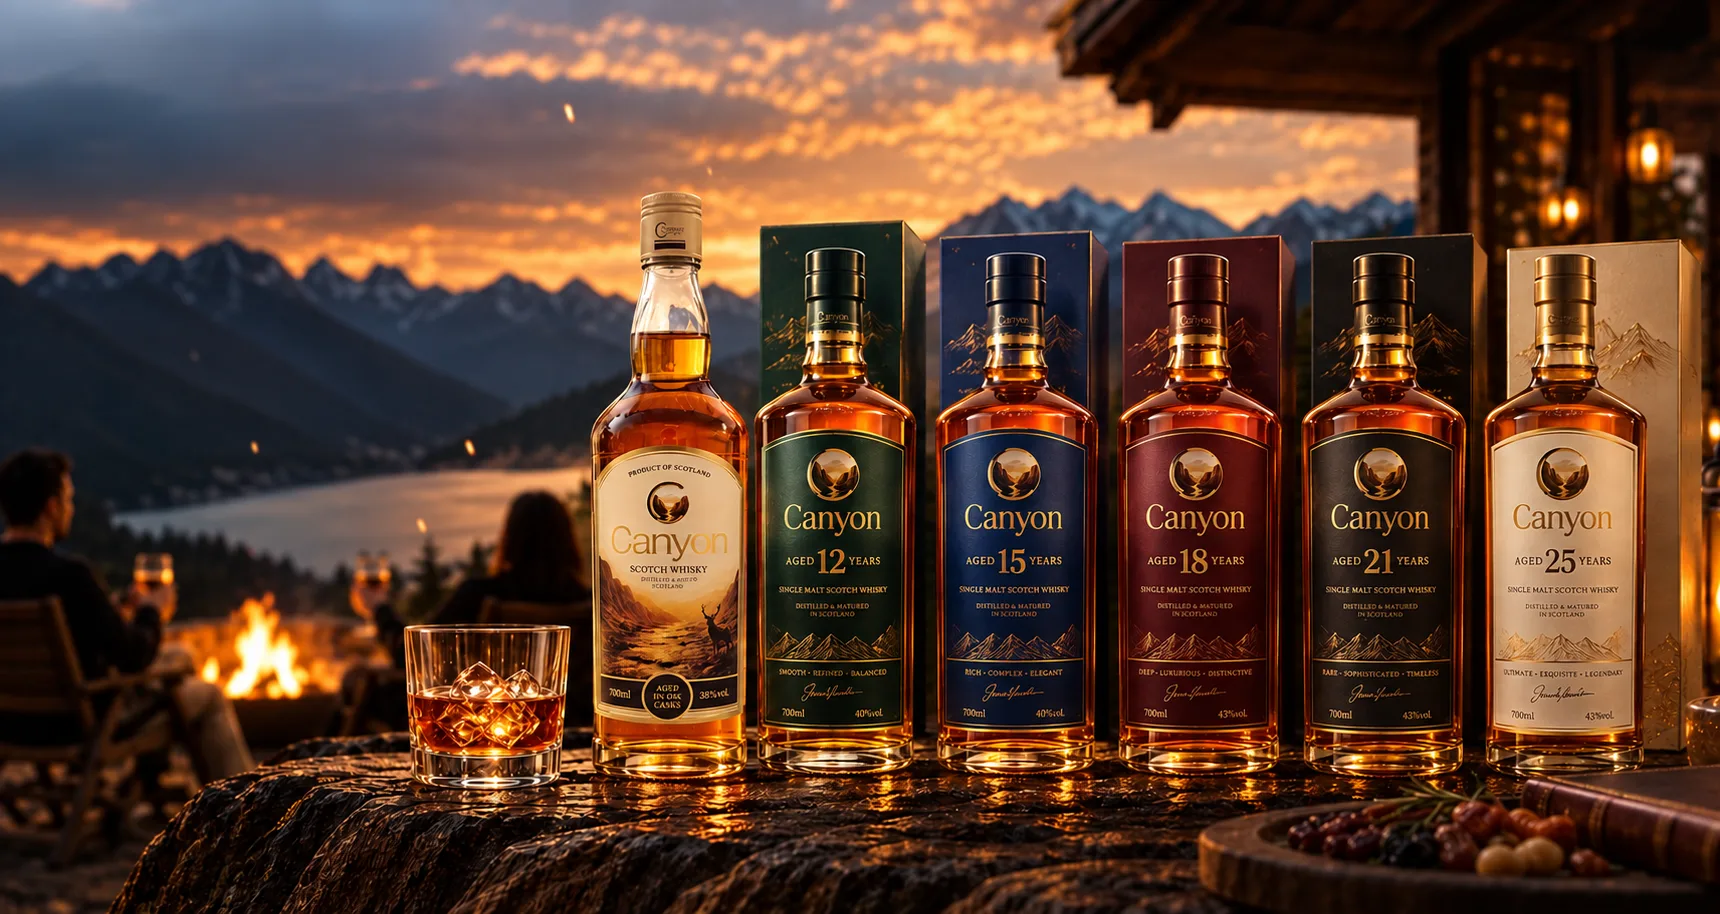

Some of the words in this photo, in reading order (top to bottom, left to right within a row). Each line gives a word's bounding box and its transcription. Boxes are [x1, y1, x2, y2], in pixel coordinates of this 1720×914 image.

[628, 465, 661, 478] PRODUCT
[674, 465, 711, 478] SCOTLAND
[784, 504, 881, 537] Canyon
[965, 504, 1063, 536] Canyon
[1146, 504, 1245, 536] Canyon
[1331, 504, 1429, 536] Canyon
[1513, 504, 1612, 536] Canyon
[612, 526, 728, 562] Canyon
[630, 565, 667, 573] SCOTCH
[786, 557, 814, 565] AGED
[818, 549, 845, 574] 12
[849, 557, 881, 565] YEARS
[966, 557, 995, 565] AGED
[998, 549, 1026, 574] 15
[1030, 557, 1062, 565] YEARS
[1148, 557, 1176, 565] AGED
[1180, 549, 1208, 574] 18
[1211, 557, 1244, 565] YEARS
[1333, 557, 1361, 565] AGED
[1364, 549, 1393, 574] 21
[1397, 557, 1429, 565] YEARS
[1515, 557, 1542, 565] AGED
[1545, 549, 1576, 573] 25
[1579, 557, 1611, 565] YEARS
[1540, 670, 1577, 678] EXQUISITE
[609, 688, 630, 699] 700ml
[654, 701, 680, 709] CASKS
[782, 708, 804, 717] 700ml
[963, 708, 985, 717] 700ml
[1144, 708, 1167, 718] 700ml
[1329, 709, 1352, 719] 700ml
[1511, 710, 1534, 720] 700ml
